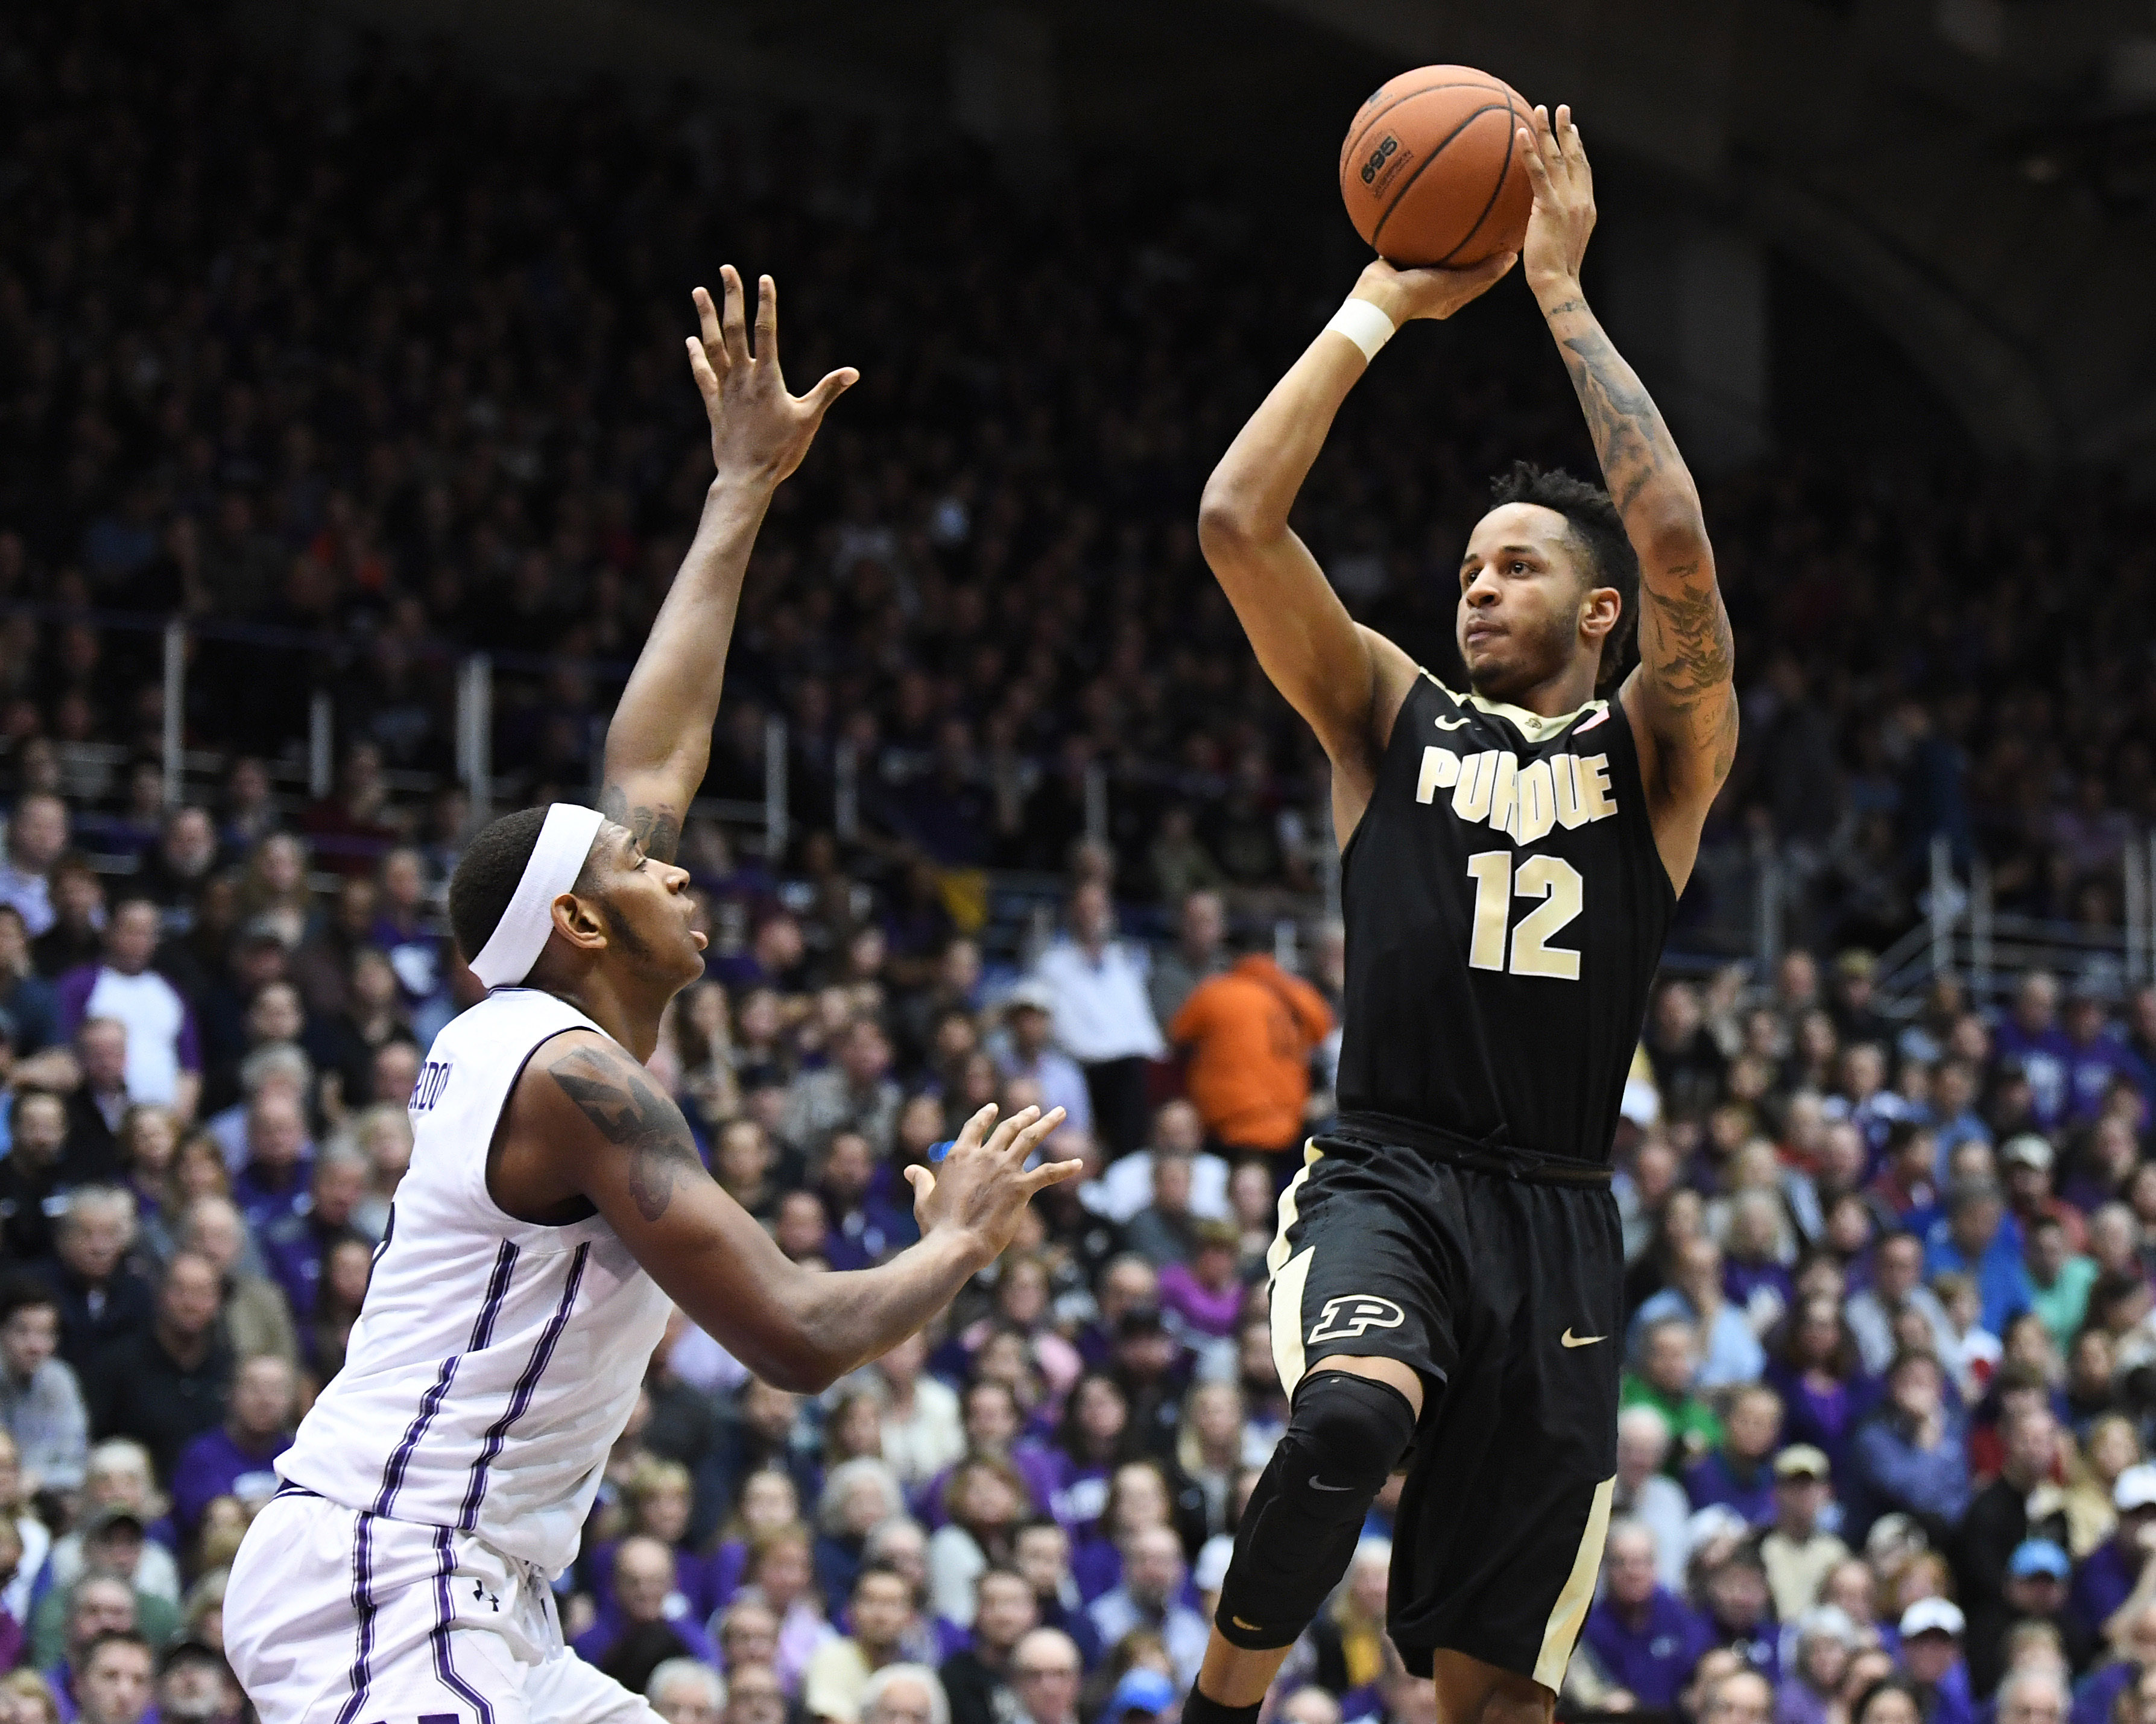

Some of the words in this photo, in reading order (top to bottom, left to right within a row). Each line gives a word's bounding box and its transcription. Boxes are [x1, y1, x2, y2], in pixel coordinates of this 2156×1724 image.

[1415, 745, 1618, 847] PURDUE
[1467, 850, 1583, 981] 12
[1307, 1294, 1405, 1345] P
